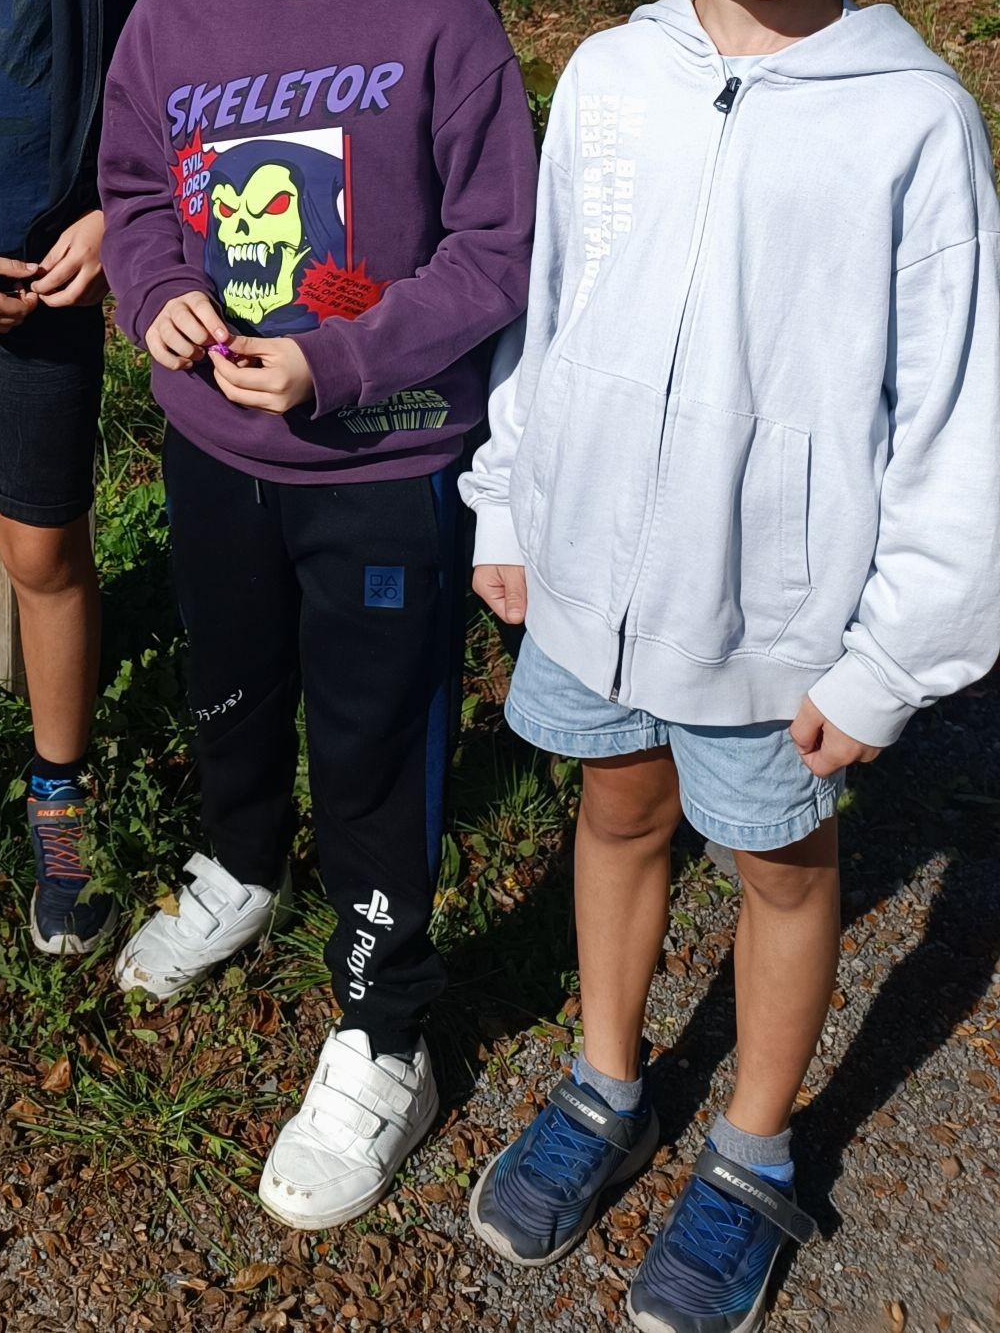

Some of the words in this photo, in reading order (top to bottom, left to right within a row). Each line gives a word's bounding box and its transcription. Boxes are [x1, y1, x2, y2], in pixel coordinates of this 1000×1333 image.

[166, 61, 404, 139] SKELETOR
[182, 151, 204, 179] EVIL
[183, 170, 211, 200] LORD
[188, 192, 204, 216] OF
[337, 409, 356, 418] OF
[360, 406, 385, 415] THE
[388, 400, 452, 412] UNIVERSE
